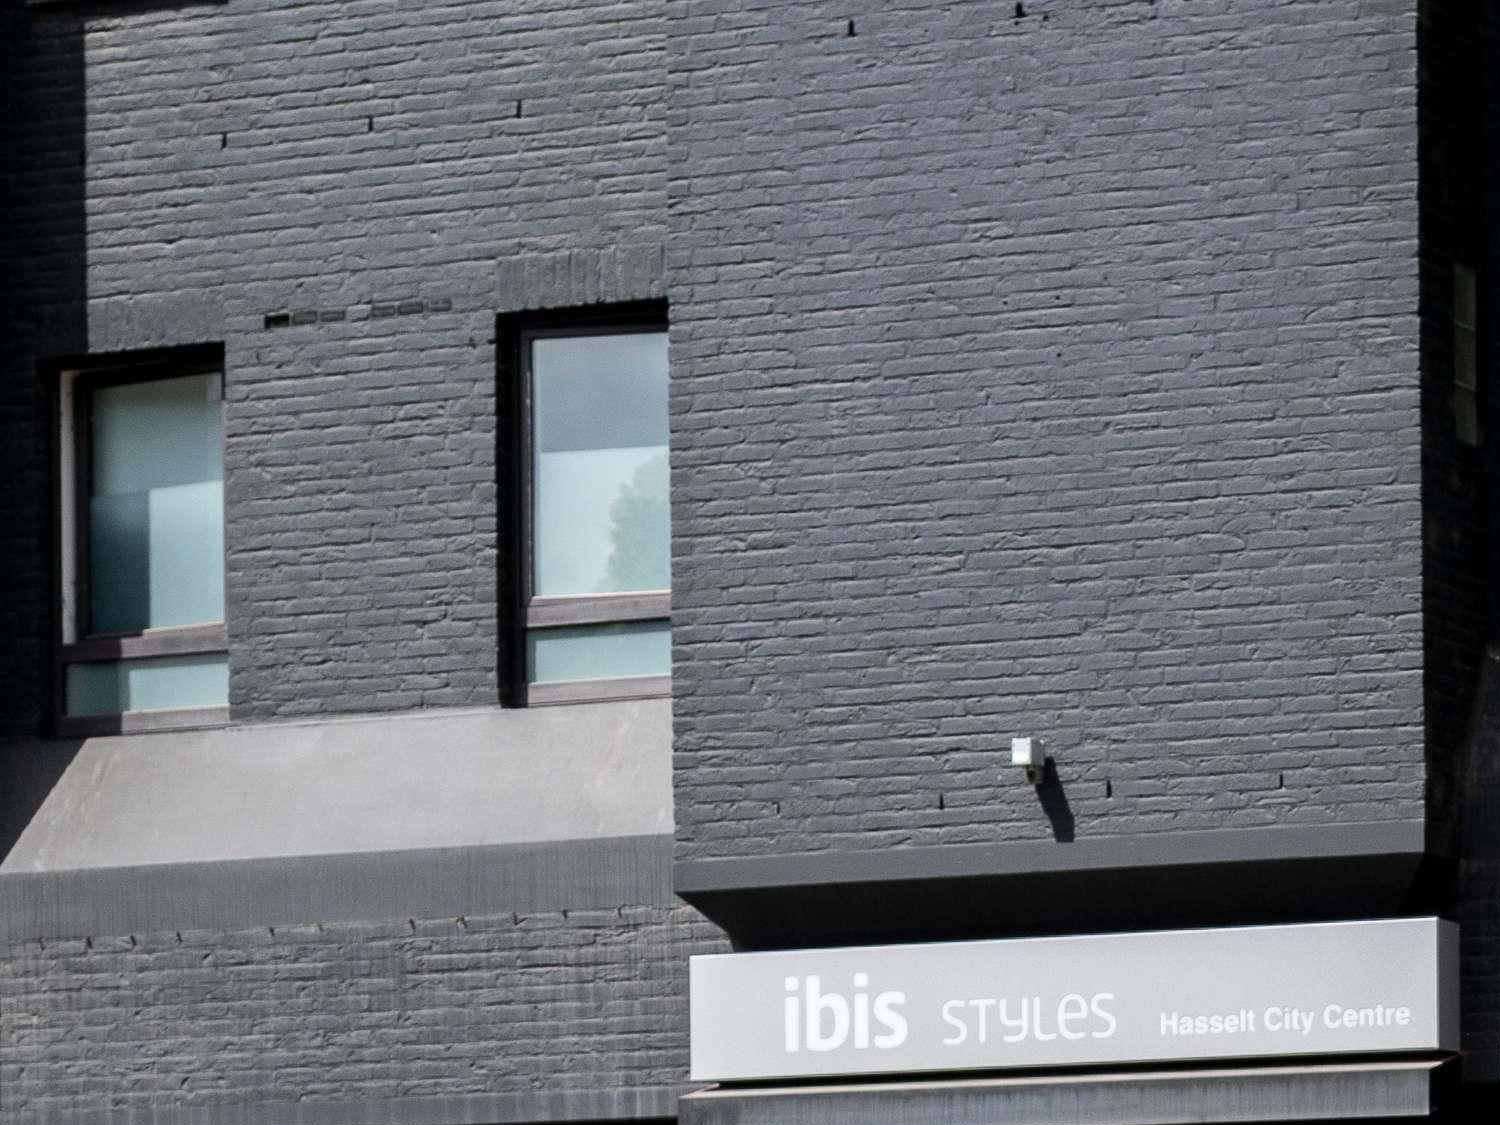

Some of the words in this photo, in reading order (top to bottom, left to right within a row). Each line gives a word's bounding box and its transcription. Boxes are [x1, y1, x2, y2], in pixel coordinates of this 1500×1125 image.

[784, 972, 908, 1053] ibis
[1160, 1008, 1256, 1038] Hasselt
[1263, 1005, 1315, 1036] City
[1321, 1002, 1411, 1031] Centre
